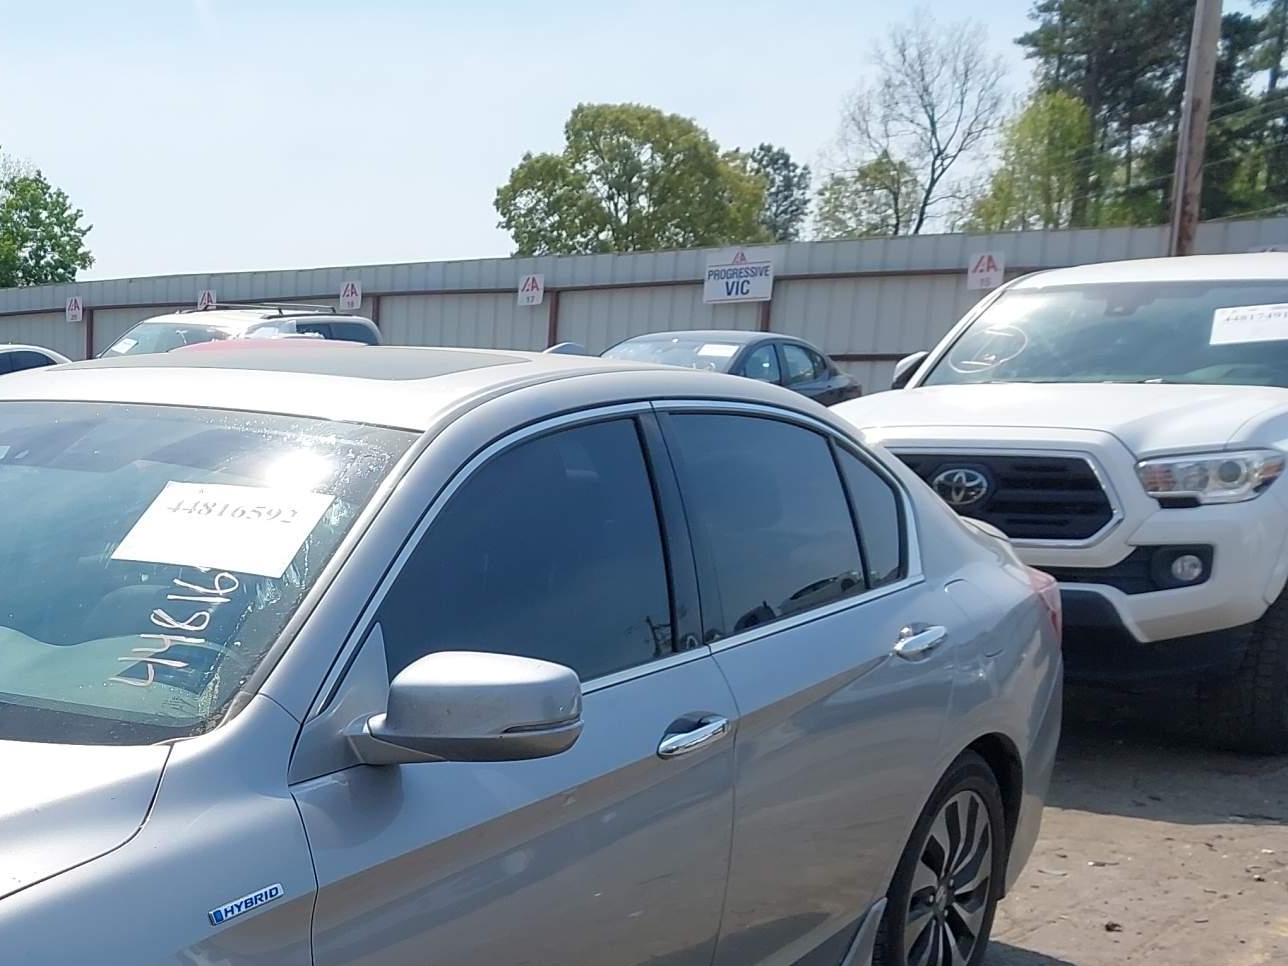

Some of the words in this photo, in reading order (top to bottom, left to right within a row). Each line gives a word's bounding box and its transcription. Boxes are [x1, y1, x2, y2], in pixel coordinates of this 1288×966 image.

[707, 265, 771, 280] PROGRESSIVE
[725, 279, 751, 296] VIC
[167, 499, 299, 524] 44816592
[108, 566, 239, 688] 44816
[224, 886, 279, 918] HYBRID
